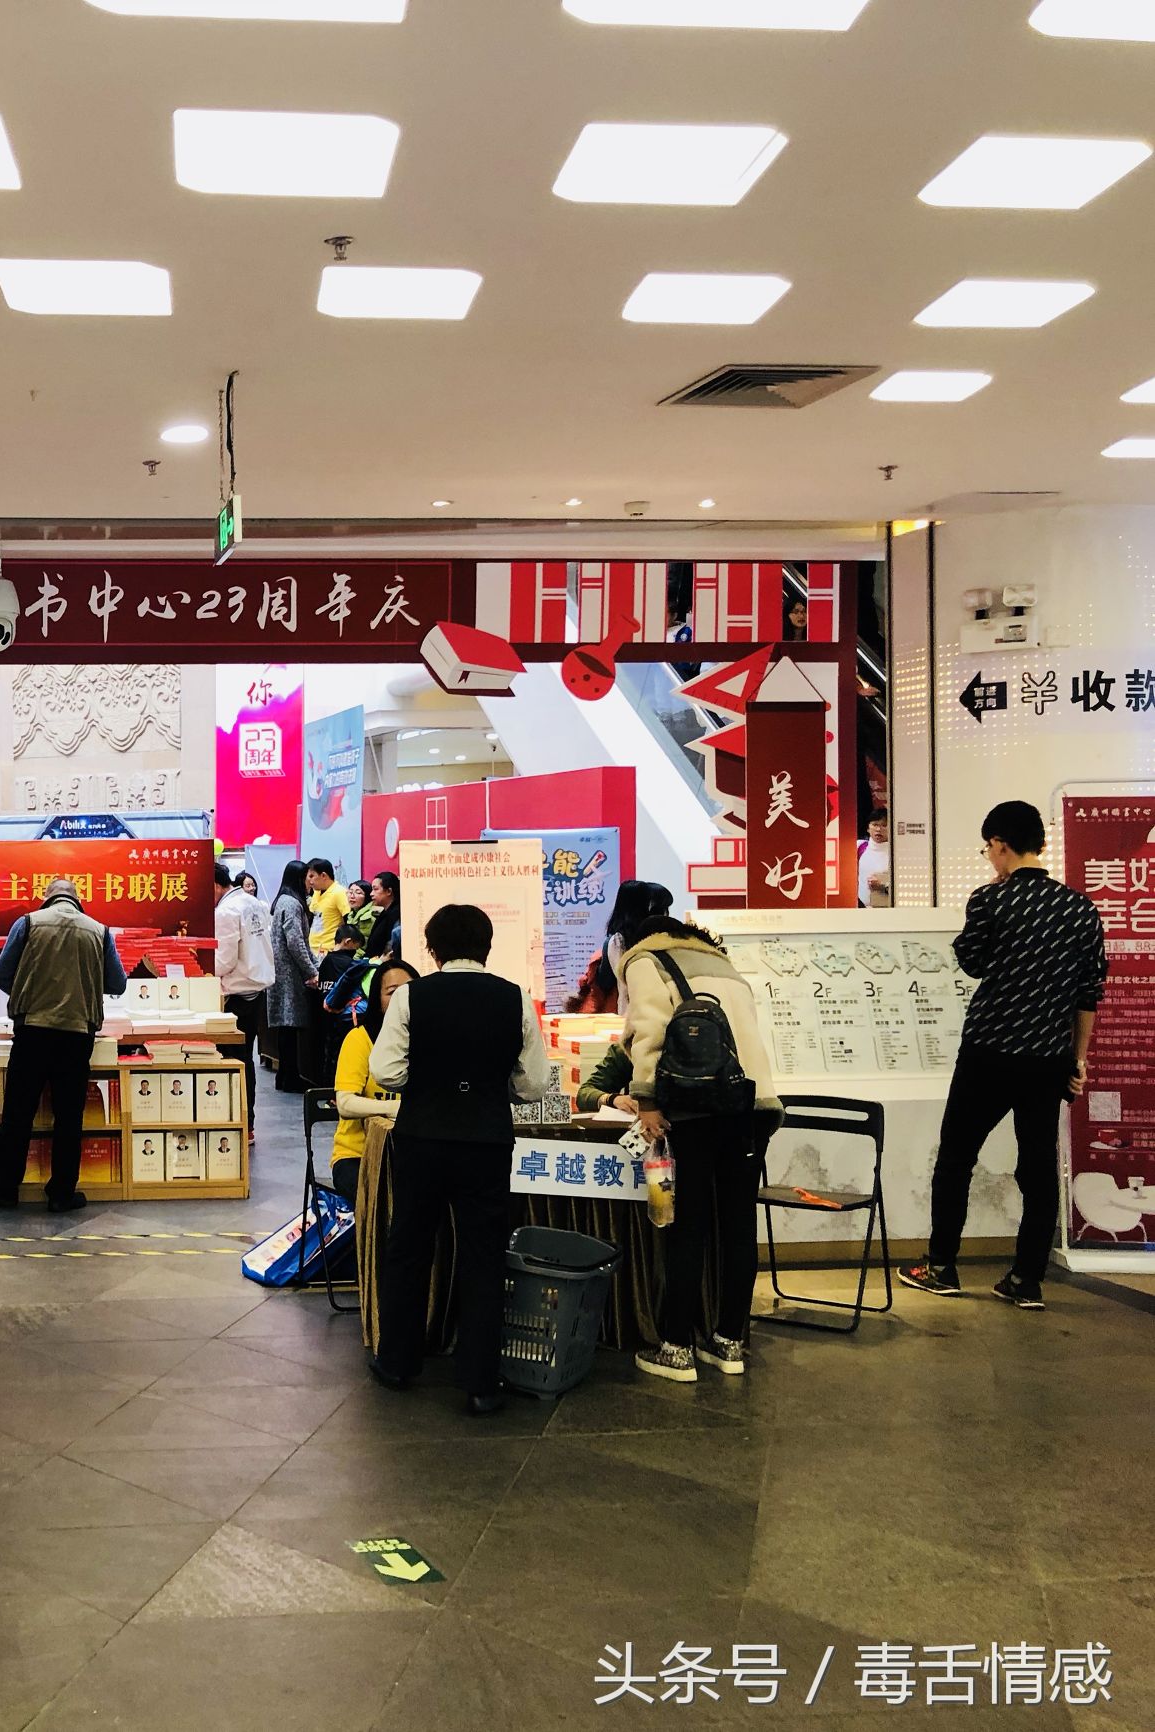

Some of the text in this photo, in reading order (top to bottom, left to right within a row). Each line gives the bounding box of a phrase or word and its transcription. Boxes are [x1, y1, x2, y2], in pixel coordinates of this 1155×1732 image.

[247, 679, 273, 706] 你
[245, 728, 276, 750] 23
[245, 750, 276, 766] 周年
[761, 770, 814, 900] 美好
[430, 851, 511, 866] 决胜全面建成小康社会
[543, 848, 582, 879] 能
[812, 981, 832, 998] 2F
[863, 981, 883, 997] 3F
[907, 980, 927, 996] 4F
[954, 980, 973, 996] 5F
